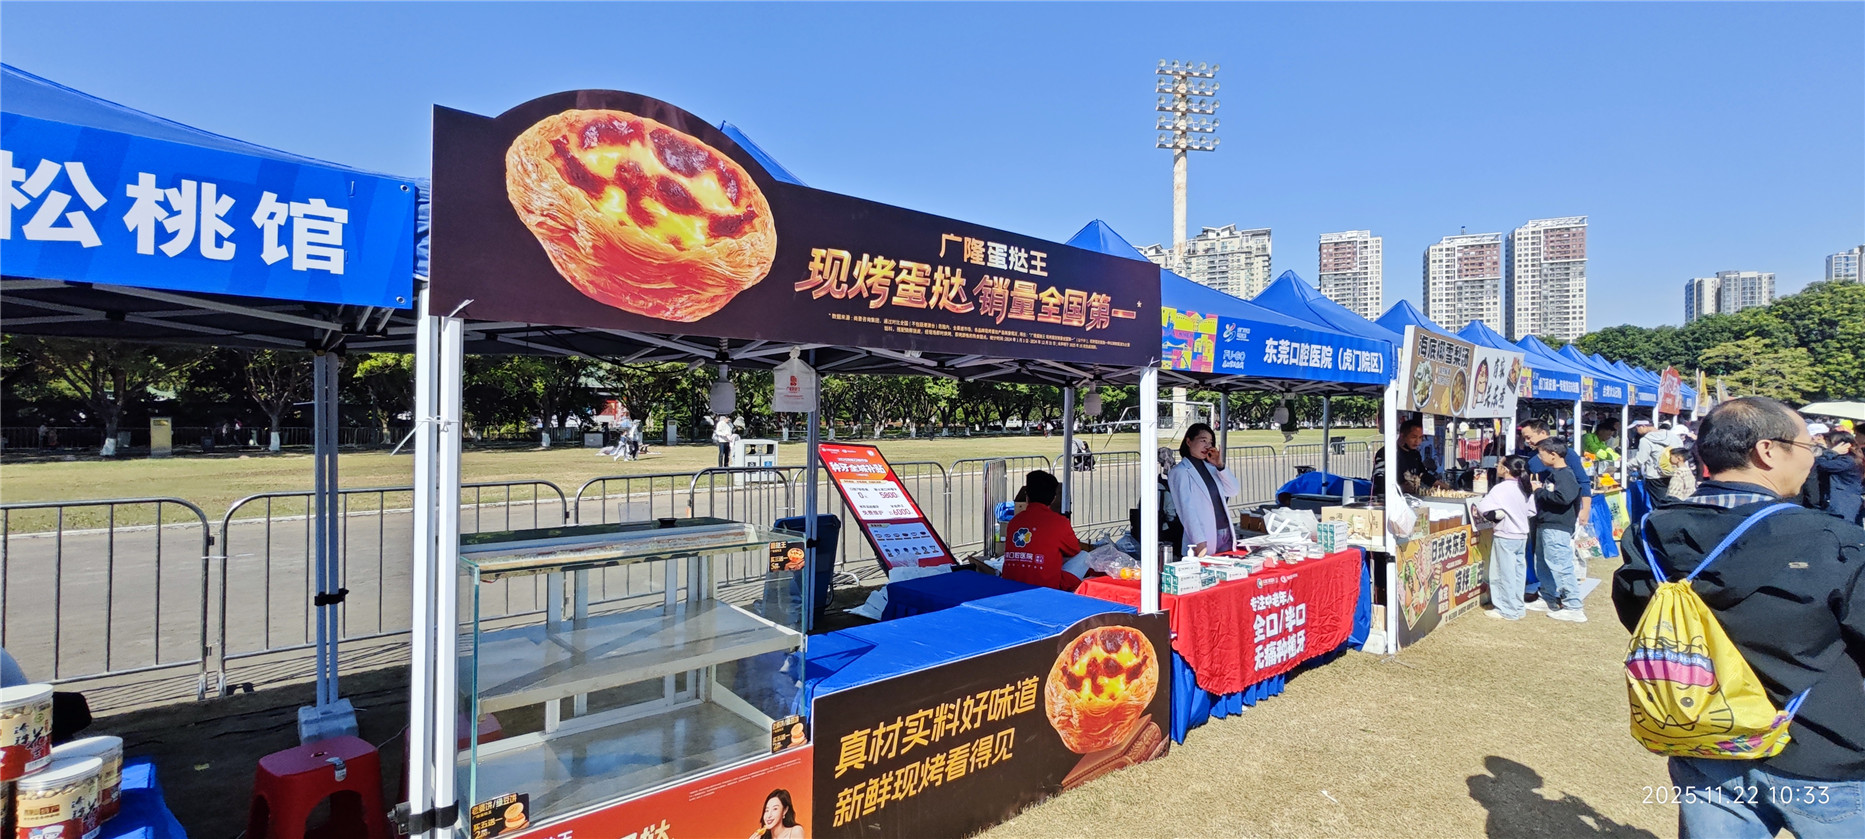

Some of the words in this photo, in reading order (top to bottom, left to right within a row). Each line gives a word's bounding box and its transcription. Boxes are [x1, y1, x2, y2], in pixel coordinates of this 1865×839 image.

[0, 149, 349, 275] 松桃馆
[939, 232, 1049, 277] 广隆蛋挞王
[794, 247, 975, 314] 现烤蛋挞
[971, 274, 1138, 332] 销量全国第一
[1263, 336, 1384, 375] 东莞口腔医院（虎门院区）
[1431, 530, 1468, 563] 日式关东煮
[1249, 589, 1295, 613] 专注中老年人
[1252, 602, 1306, 644] 全口/半口
[1253, 635, 1306, 672] 无痛种植牙
[834, 675, 1040, 780] 真材实料好味道
[832, 727, 1016, 829] 新鲜现烤看得见
